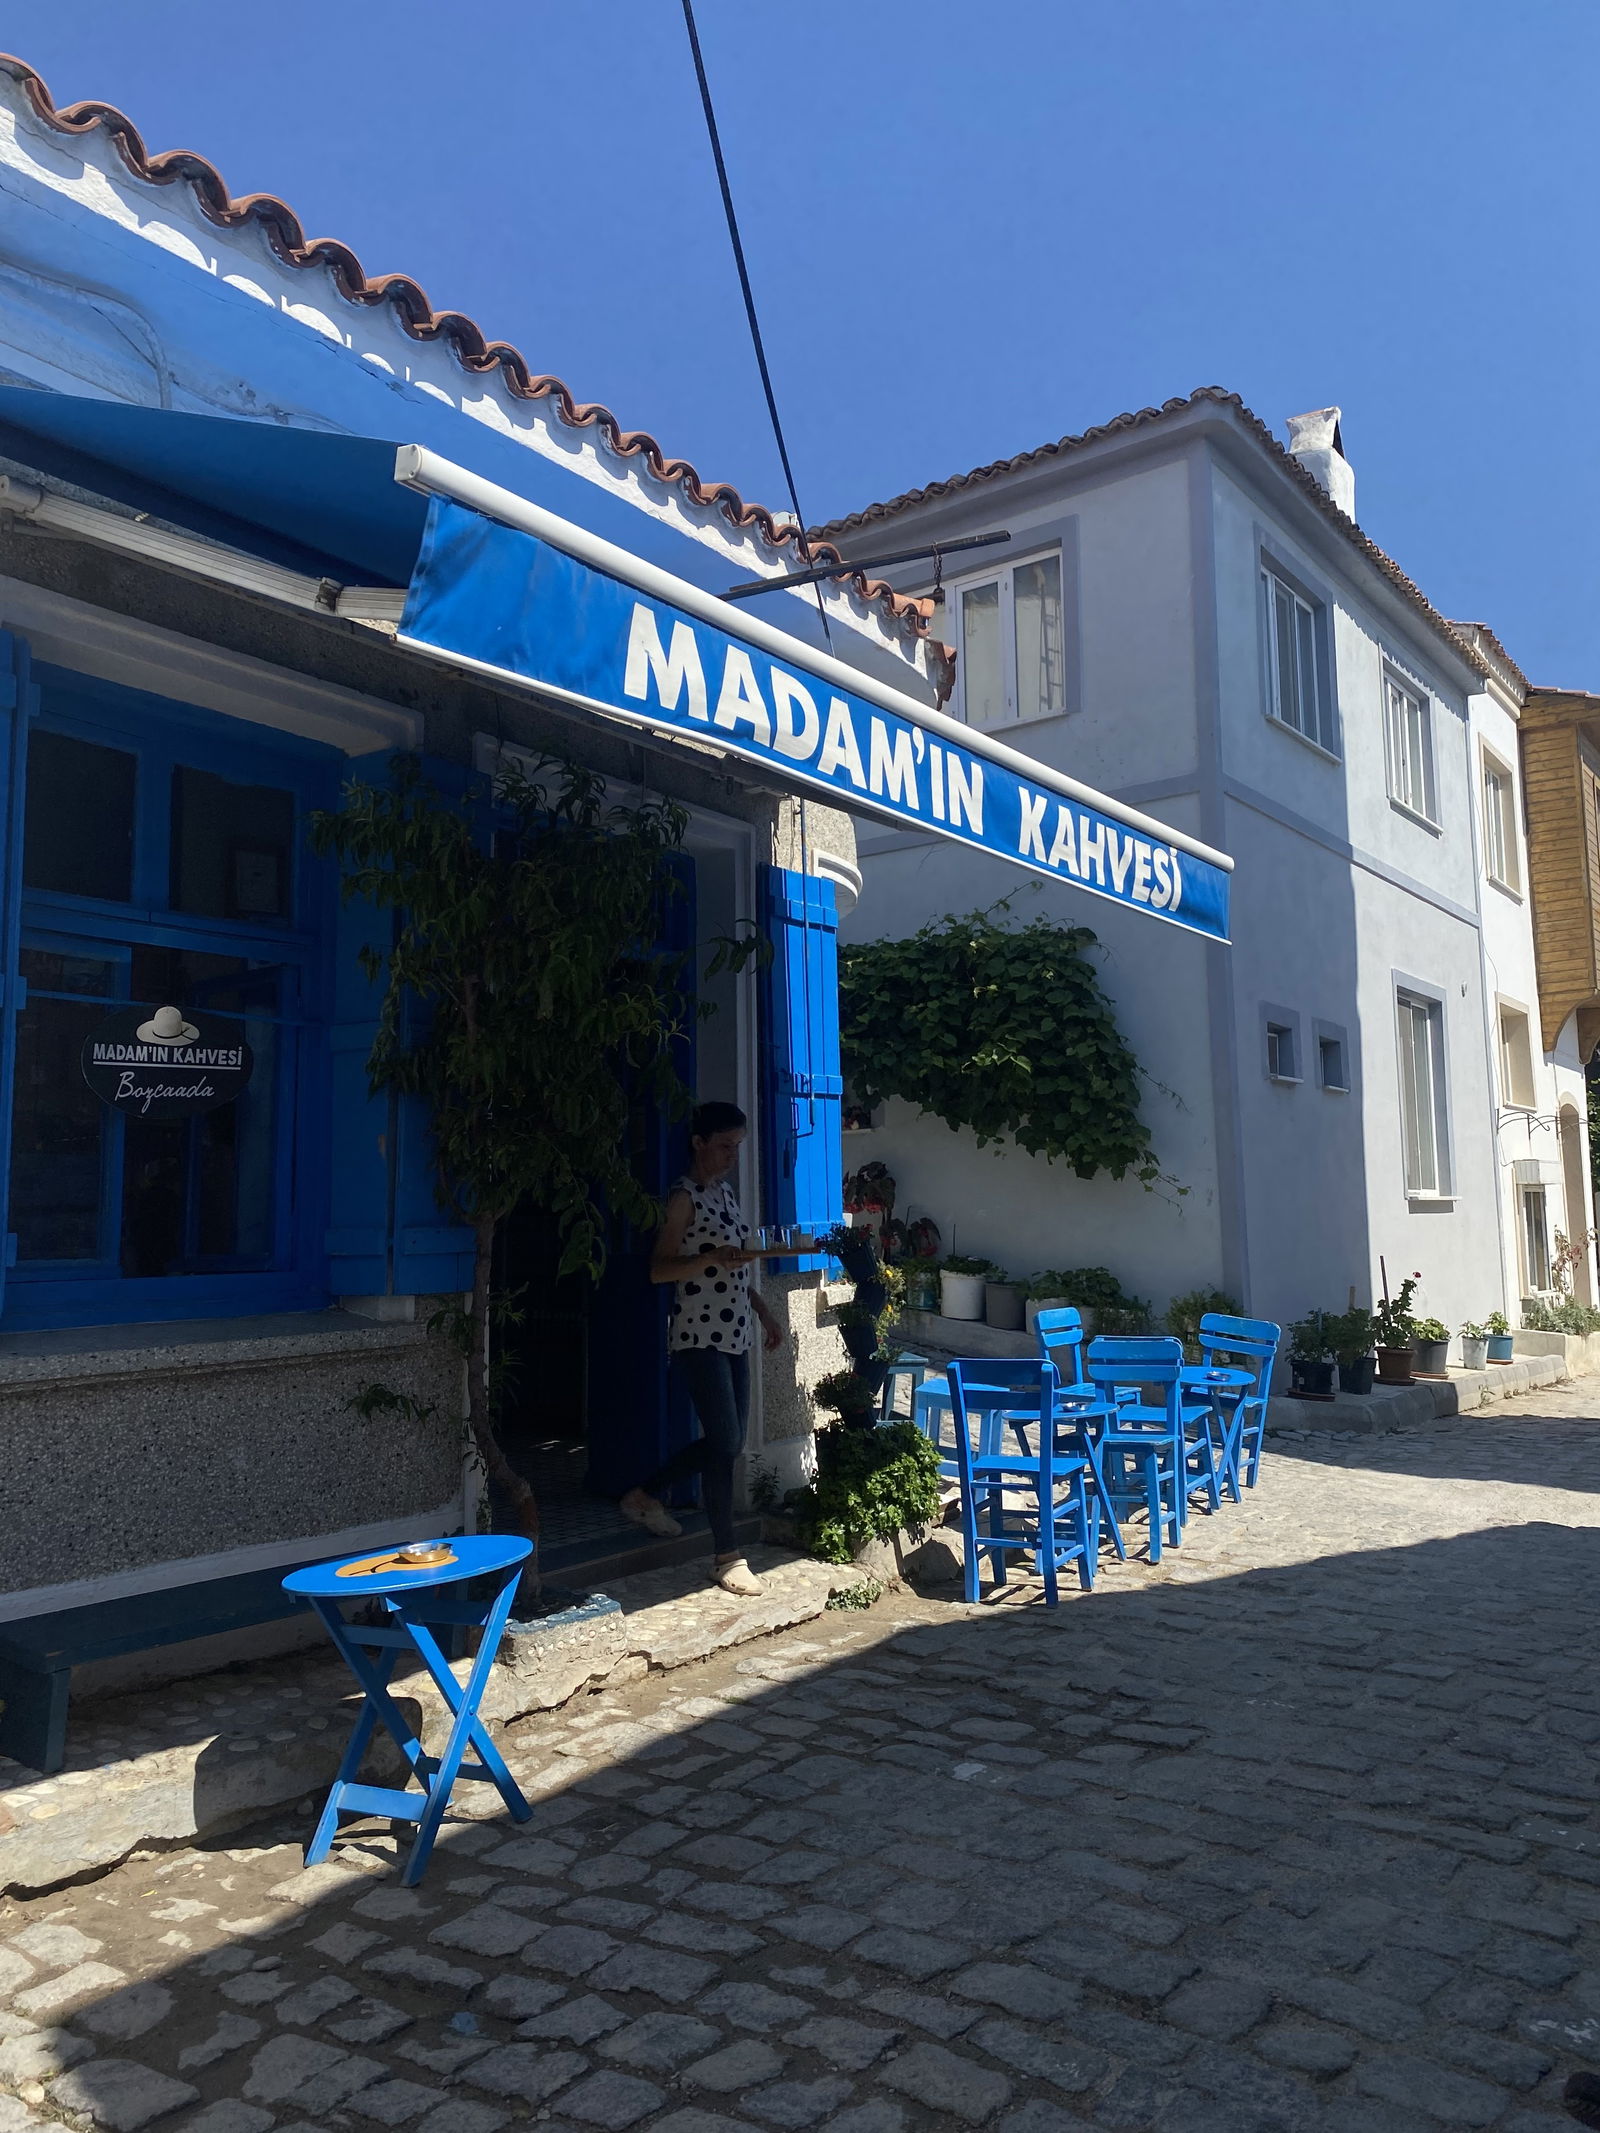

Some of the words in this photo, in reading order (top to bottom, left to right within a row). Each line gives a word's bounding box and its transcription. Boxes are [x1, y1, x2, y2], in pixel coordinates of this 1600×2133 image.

[623, 602, 985, 836] MADAM'IN
[1017, 786, 1183, 912] KAHVESİ
[93, 1043, 169, 1062] MADAM'IN
[173, 1046, 242, 1066] KAHVESİ
[115, 1071, 214, 1113] Bozcaada
